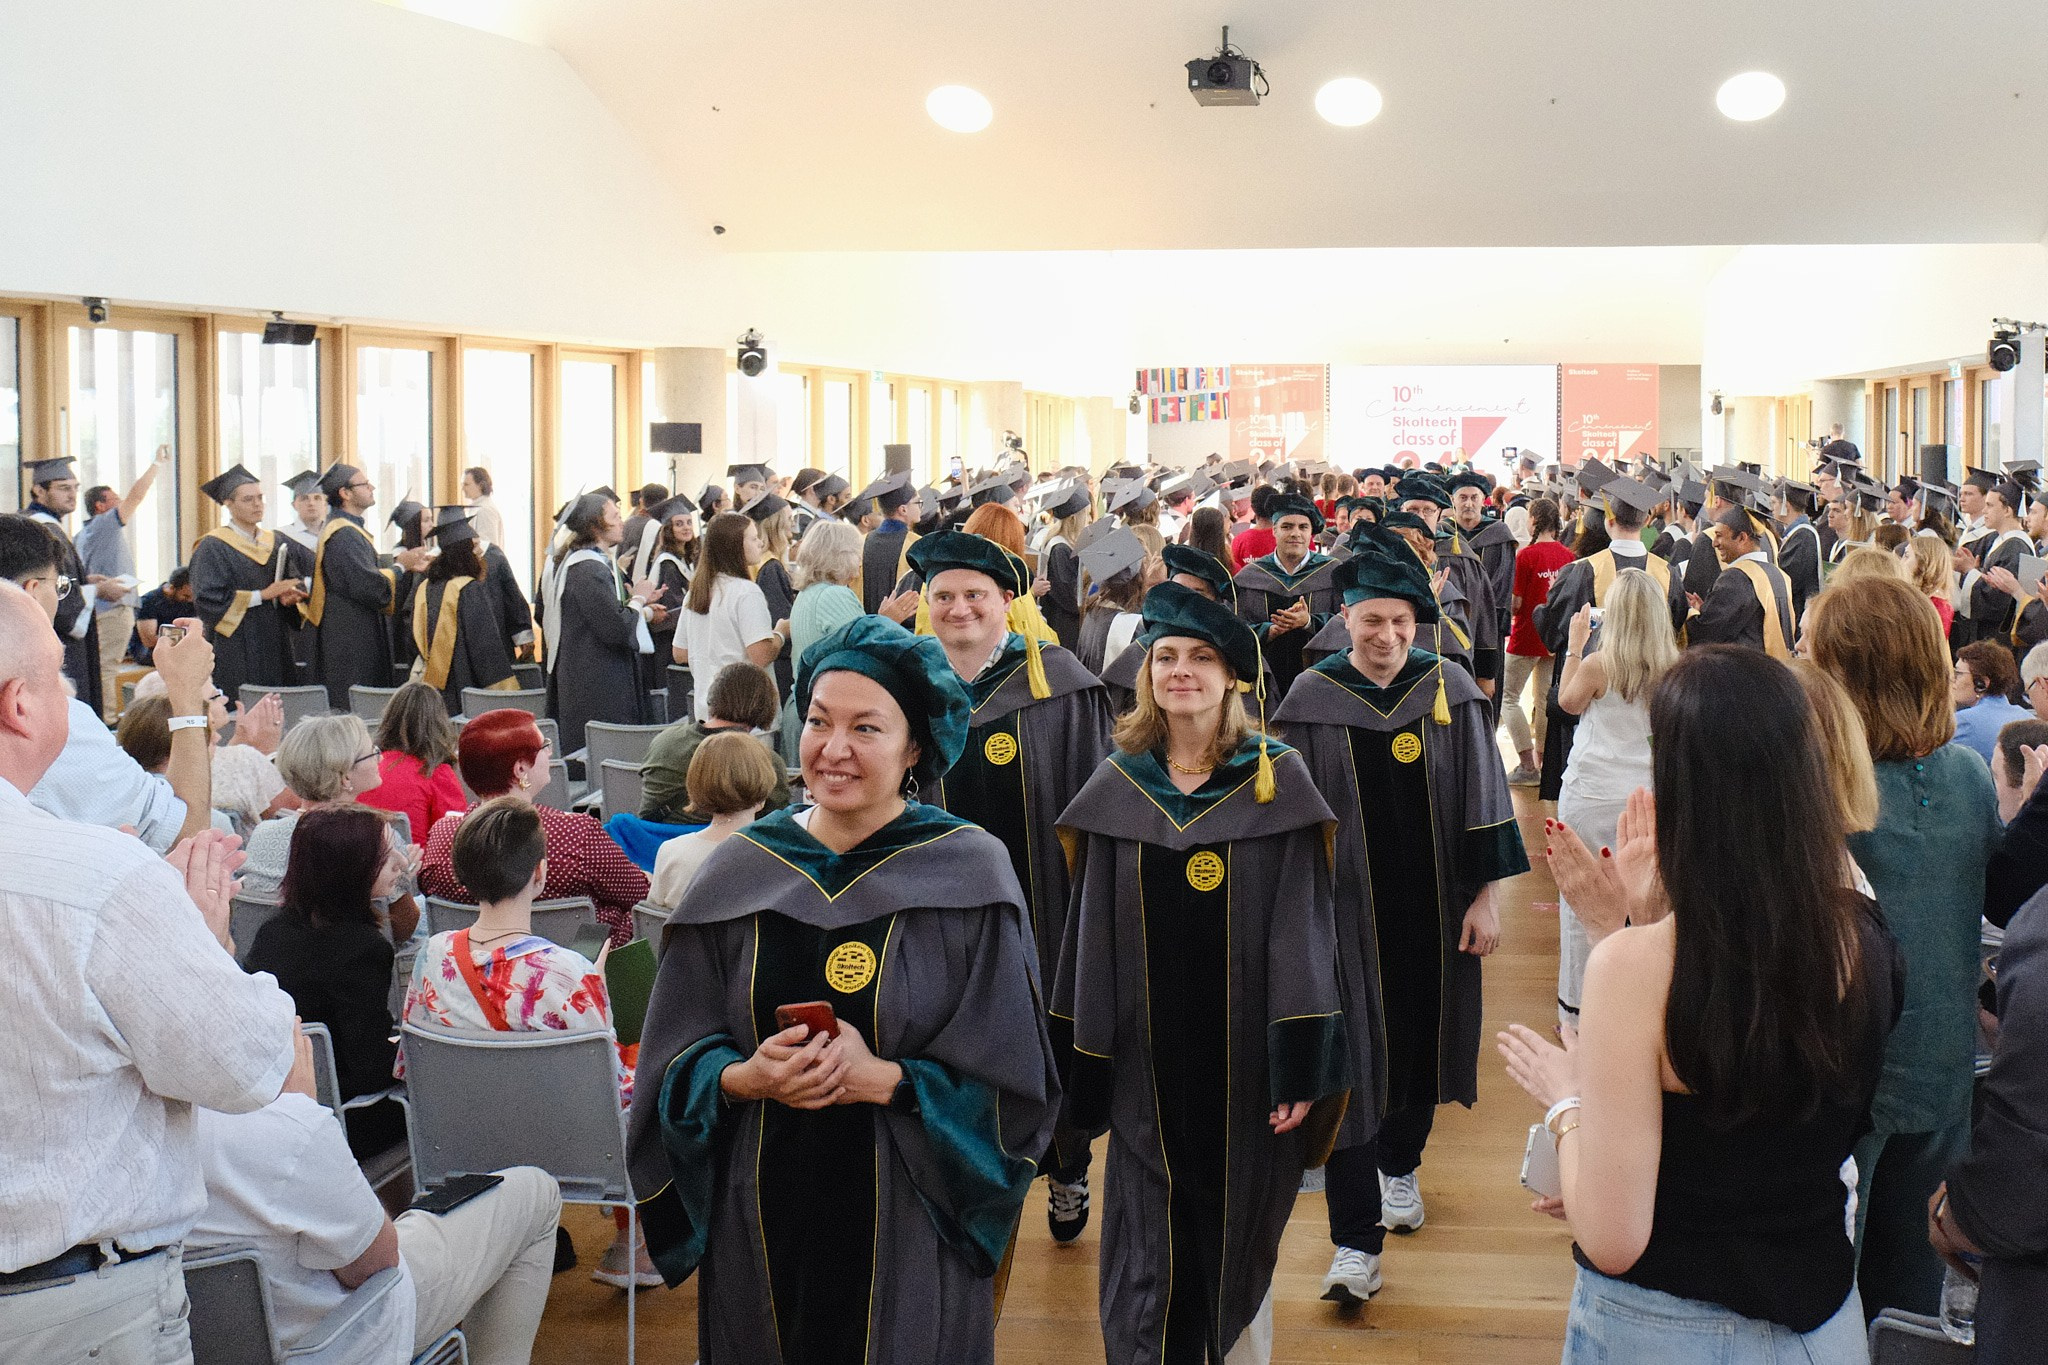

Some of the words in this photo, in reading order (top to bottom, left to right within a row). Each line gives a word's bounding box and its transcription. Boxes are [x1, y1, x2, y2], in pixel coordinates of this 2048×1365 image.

[1568, 368, 1598, 376] Skoltech
[1392, 385, 1423, 402] 10th
[1392, 416, 1457, 427] Skoltech
[1582, 414, 1600, 424] 10th
[1249, 437, 1272, 447] class
[1273, 437, 1284, 447] of
[1392, 429, 1434, 446] class
[1438, 429, 1457, 446] of
[1582, 437, 1605, 447] class
[1606, 437, 1617, 447] of
